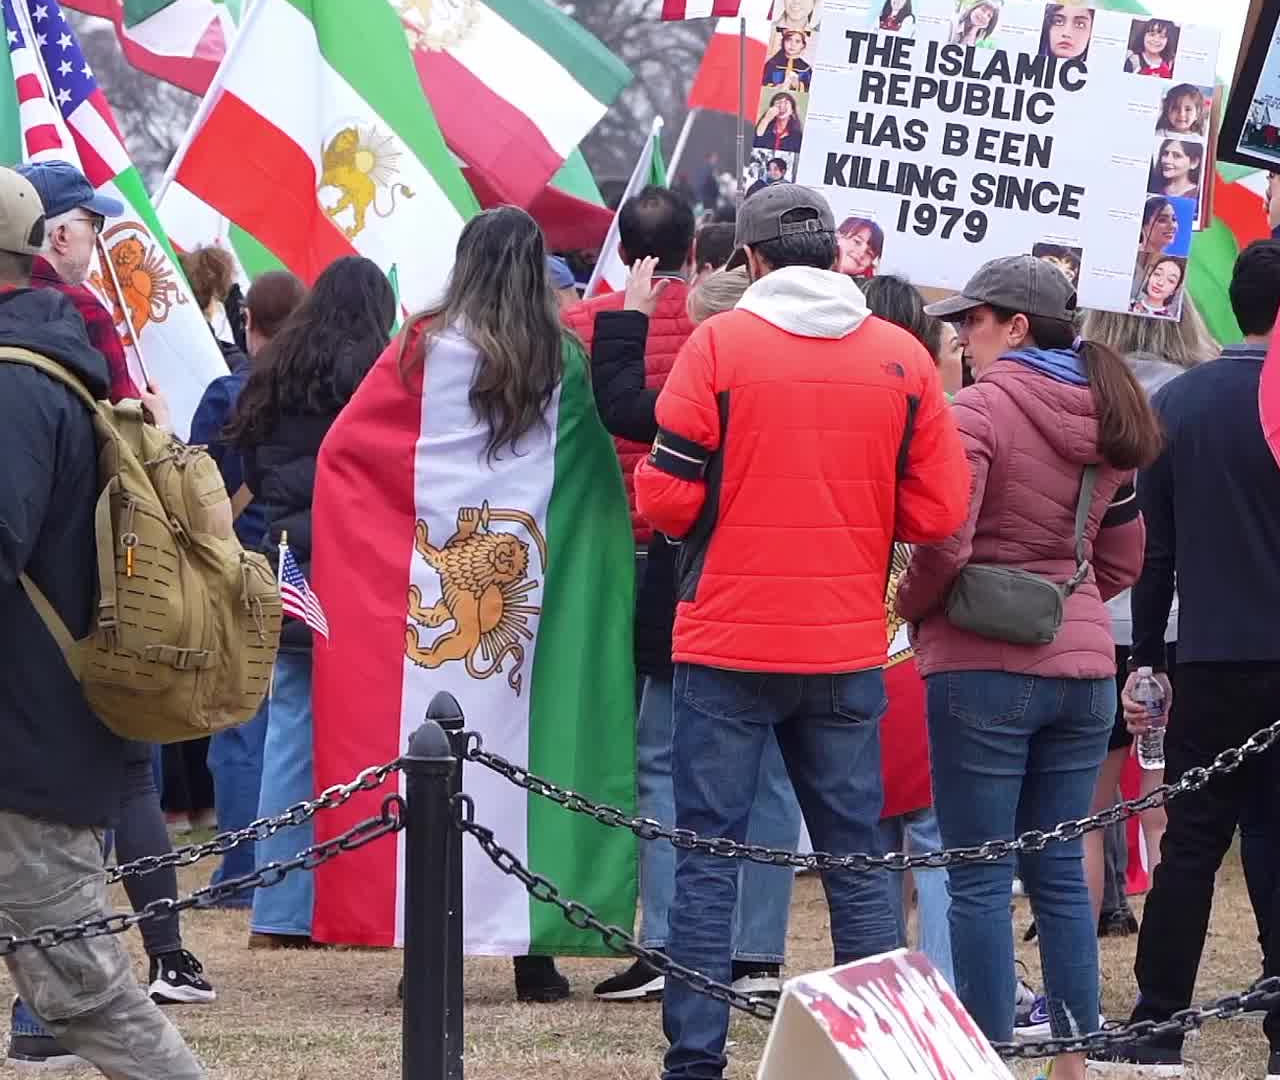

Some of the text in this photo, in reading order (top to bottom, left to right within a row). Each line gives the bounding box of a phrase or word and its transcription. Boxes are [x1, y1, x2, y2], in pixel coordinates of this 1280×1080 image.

[846, 29, 1089, 92] THE ISLAMIC
[859, 70, 1055, 124] REPUBLIC
[845, 111, 1053, 168] HAS BEEN
[824, 153, 1085, 219] KILLING SINCE
[897, 200, 988, 243] 1979
